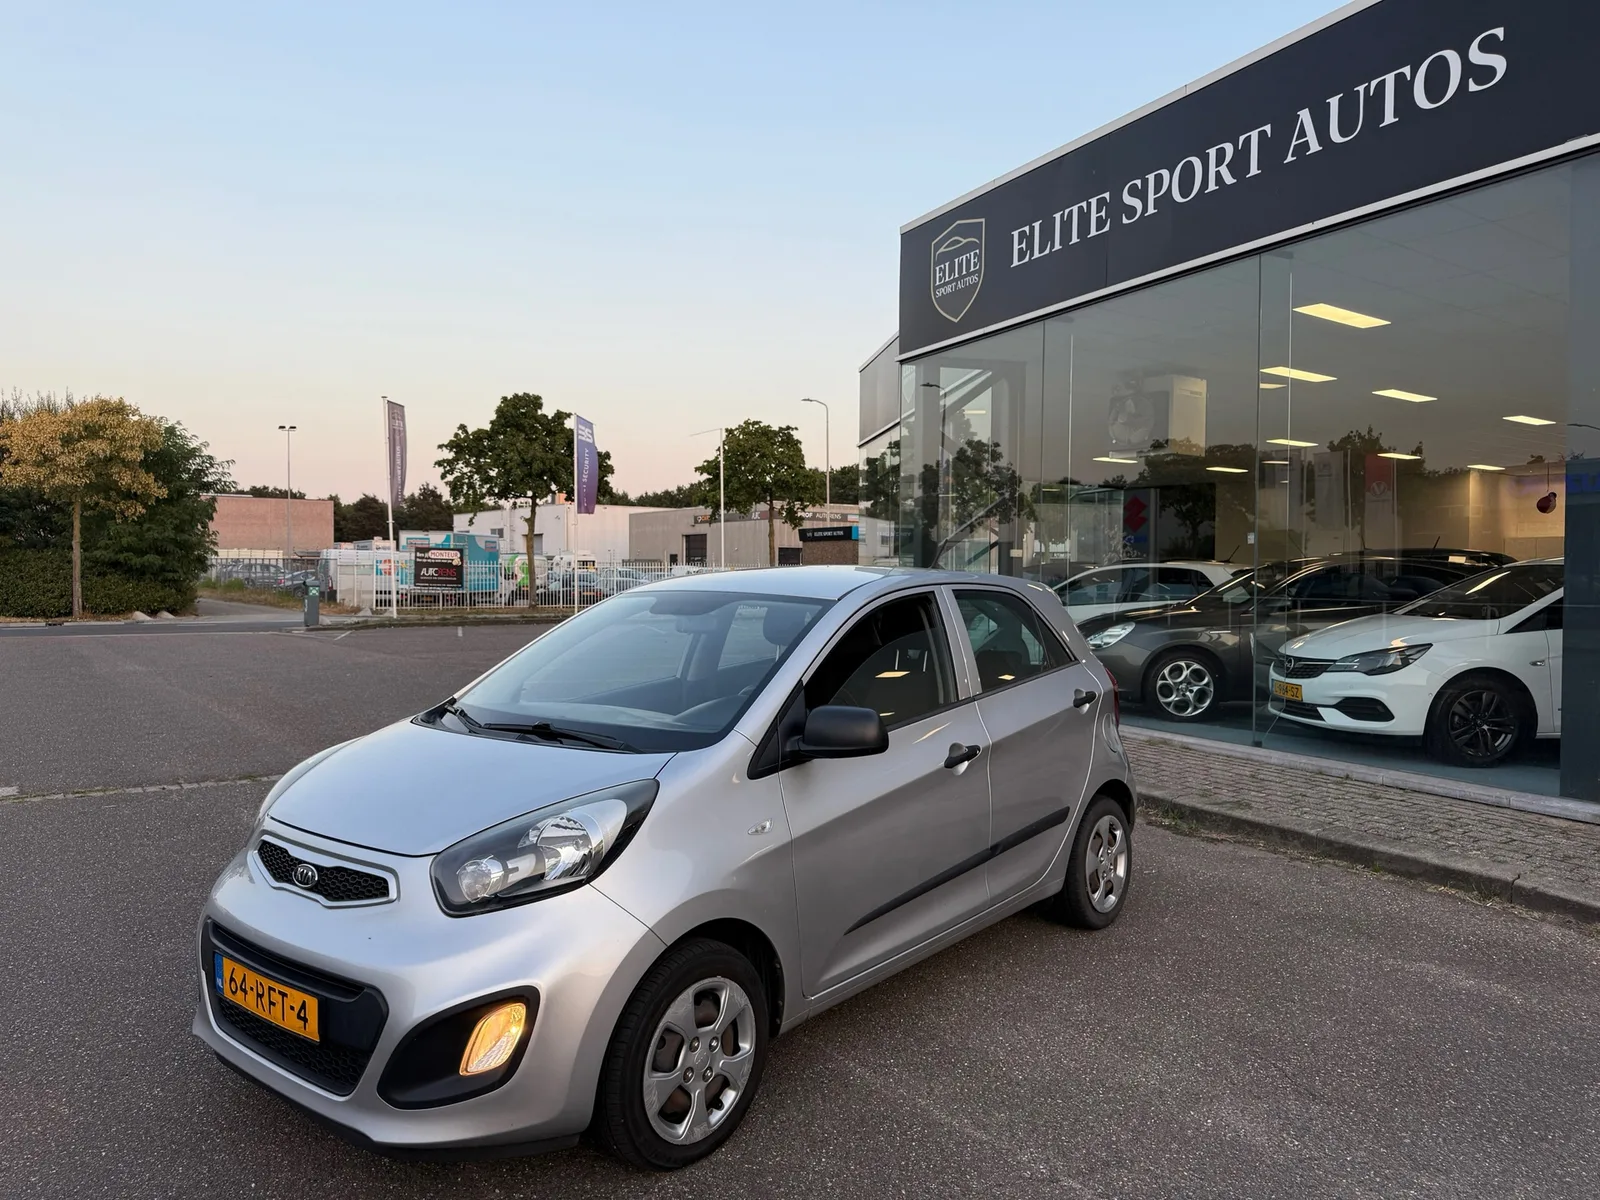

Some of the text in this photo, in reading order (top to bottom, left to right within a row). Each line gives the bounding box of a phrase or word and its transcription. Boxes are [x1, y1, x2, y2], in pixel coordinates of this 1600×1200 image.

[1010, 27, 1507, 268] ELITE SPORT AUTOS
[934, 249, 980, 286] ELITE
[935, 274, 979, 299] SPORT AUTOS
[581, 447, 590, 483] SECURITY
[296, 867, 312, 884] KIA
[216, 977, 224, 989] NL
[228, 967, 309, 1031] 64-RFT-4
